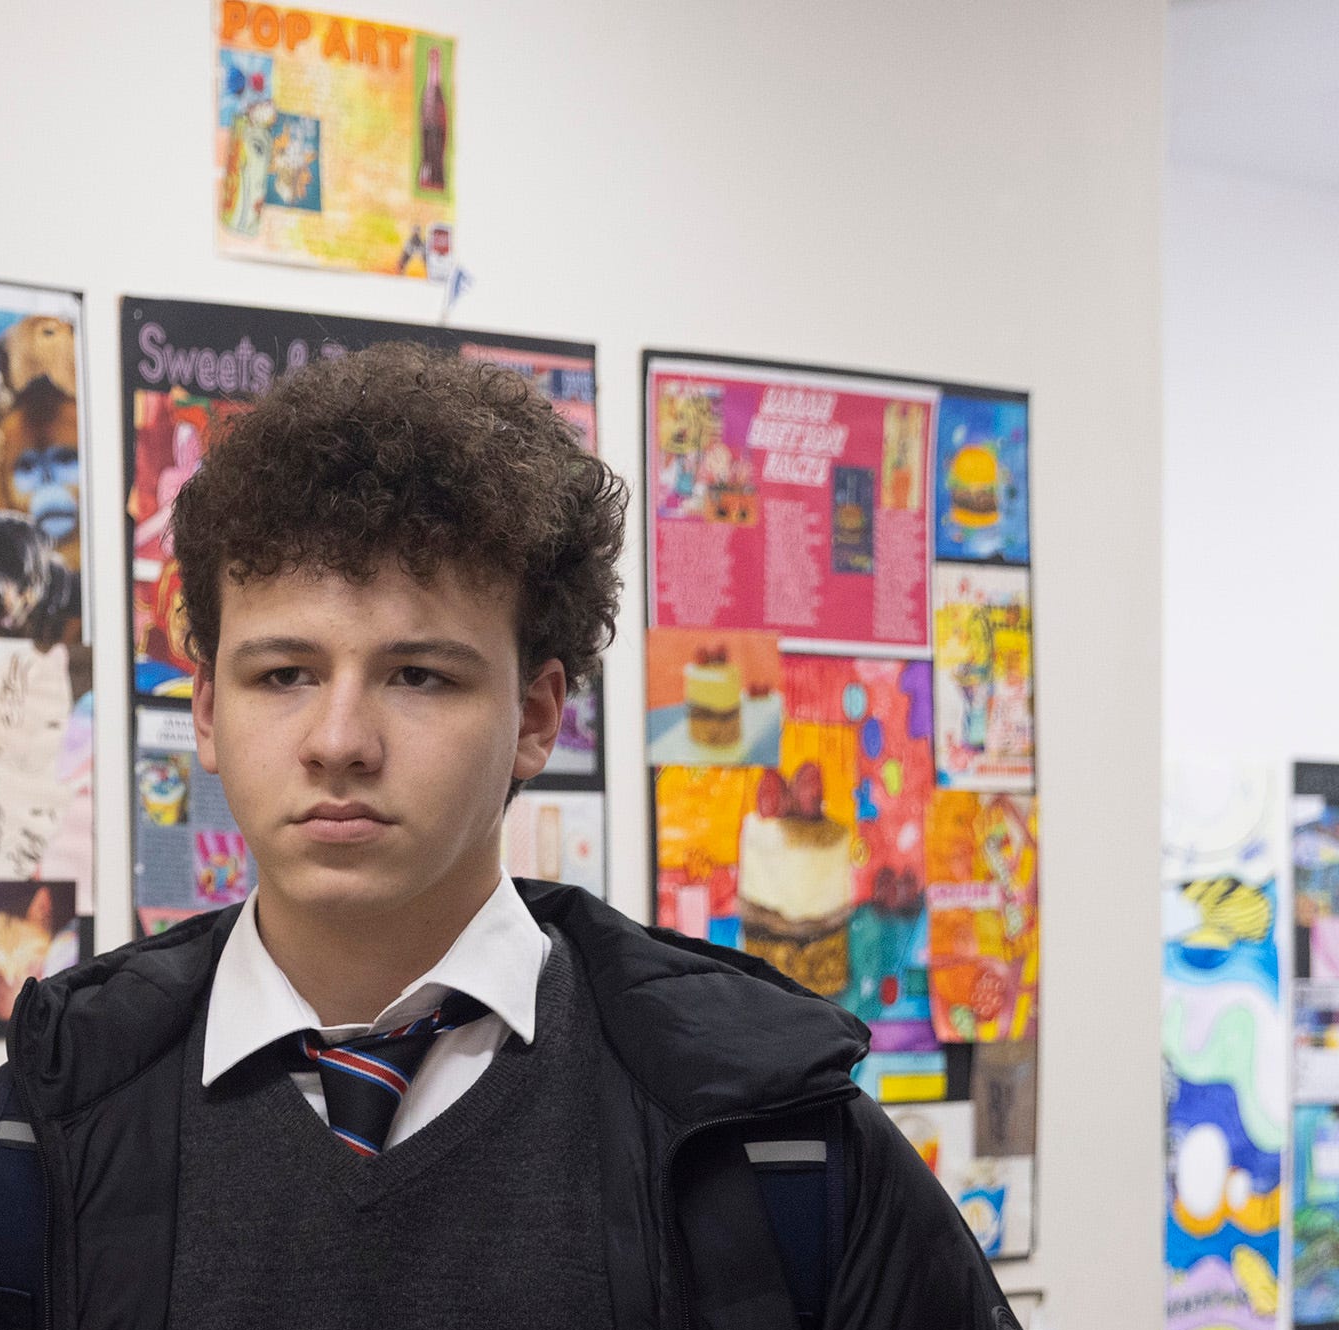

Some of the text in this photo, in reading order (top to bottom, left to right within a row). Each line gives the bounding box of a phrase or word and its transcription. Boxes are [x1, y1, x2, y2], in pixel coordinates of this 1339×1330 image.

[220, 1, 407, 70] POP ART
[138, 321, 274, 398] Sweets
